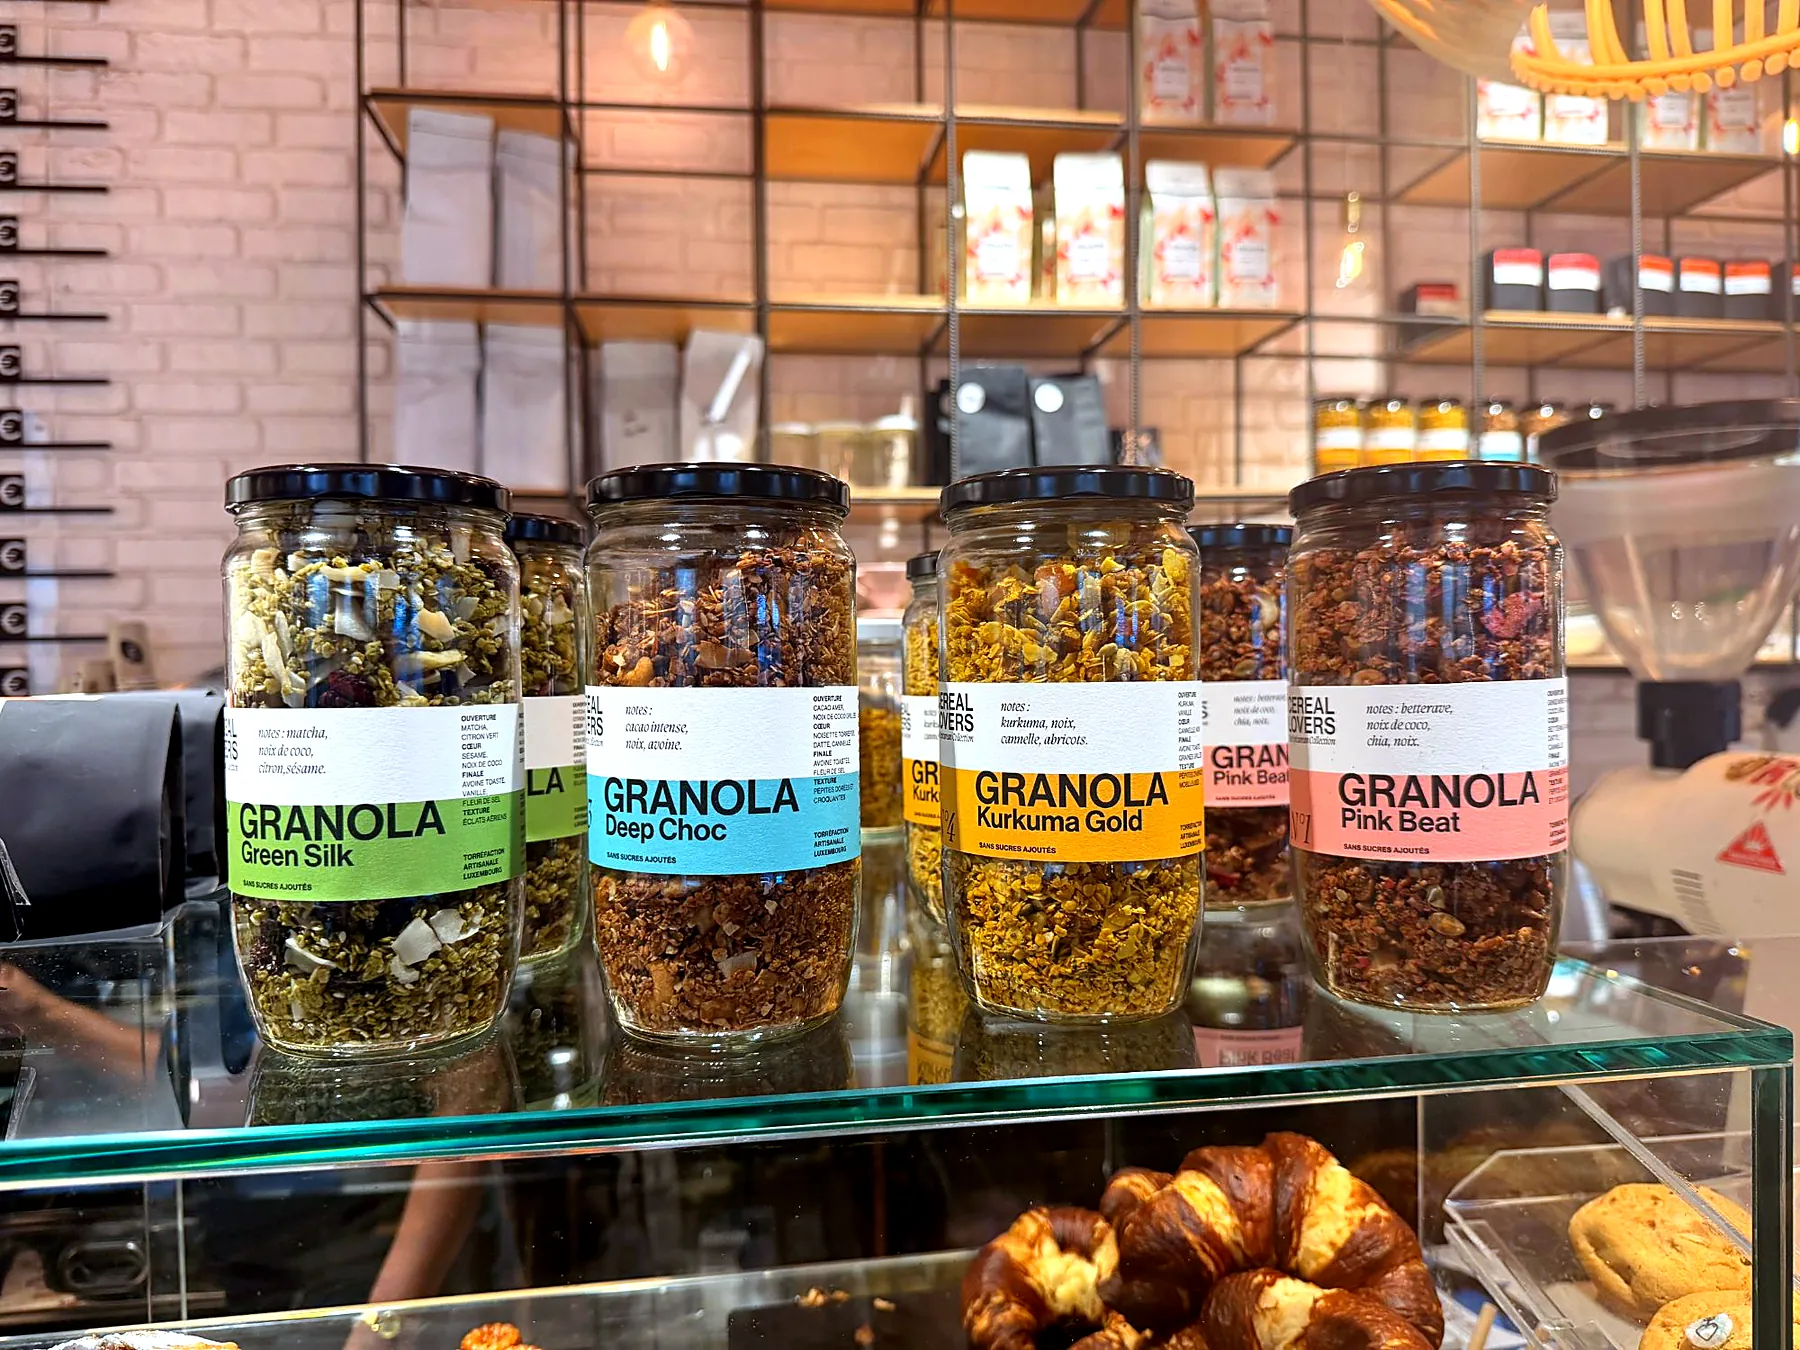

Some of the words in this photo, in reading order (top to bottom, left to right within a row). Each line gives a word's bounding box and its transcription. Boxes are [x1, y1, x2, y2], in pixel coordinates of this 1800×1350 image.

[625, 706, 648, 716] notes
[1000, 702, 1026, 712] notes
[1366, 704, 1394, 714] notes
[1401, 702, 1453, 714] betterave,
[625, 722, 650, 732] cacao
[650, 721, 688, 734] intense,
[1000, 716, 1048, 730] kurkuma,
[1051, 717, 1076, 730] noix,
[1366, 718, 1390, 730] noix
[1391, 718, 1403, 730] de
[1404, 721, 1430, 732] coco,
[258, 729, 280, 738] notes
[287, 726, 328, 740] matcha,
[1000, 733, 1042, 746] cannelle,
[1044, 733, 1088, 746] abricots.
[626, 738, 646, 751] noix,
[648, 738, 682, 750] avoine.
[1367, 734, 1391, 748] chia,
[1394, 734, 1420, 747] noix.
[258, 744, 276, 756] noix
[278, 744, 289, 756] de
[290, 747, 314, 758] coco,
[813, 777, 837, 786] TEXTURE
[1214, 771, 1253, 786] Pink
[604, 777, 800, 816] GRANOLA
[976, 771, 1168, 808] GRANOLA
[1338, 771, 1540, 808] GRANOLA
[462, 807, 490, 816] TEXTURE
[240, 800, 446, 841] GRANOLA
[978, 806, 1080, 832] Kurkuma
[1086, 809, 1142, 832] Gold
[1341, 808, 1394, 832] Pink
[1398, 812, 1460, 832] Beat
[606, 814, 654, 844] Deep
[659, 818, 726, 841] Choc
[814, 838, 844, 848] ARTISANALE
[979, 842, 994, 850] SANS
[995, 844, 1022, 852] SUCRES
[1022, 846, 1056, 854] AJOUTÉS
[1344, 843, 1361, 851] SANS
[1362, 845, 1392, 853] SUCRES
[1393, 846, 1430, 854] AJOUTÉS
[241, 840, 298, 866] Green
[304, 843, 354, 867] Silk
[607, 852, 620, 860] SANS
[620, 853, 644, 862] SUCRES
[645, 855, 676, 864] AJOUTÉS
[464, 858, 499, 870] ARTISANALE
[463, 866, 502, 880] LUXEMBOURG
[243, 880, 256, 888] SANS
[256, 881, 278, 890] SUCRES
[280, 882, 312, 891] AJOUTÉS
